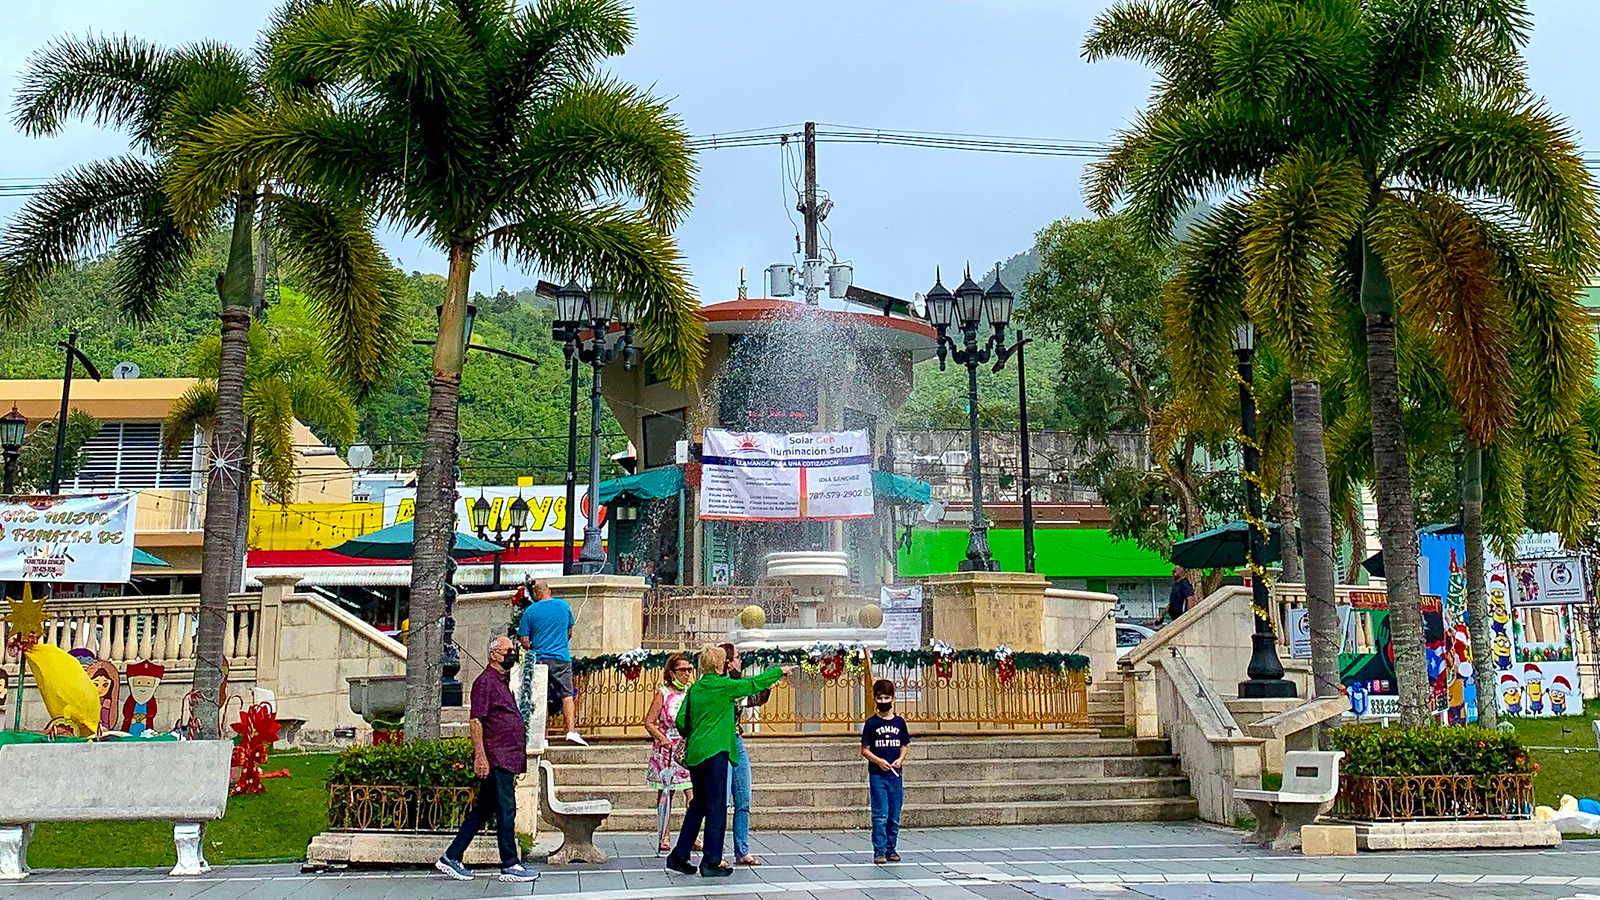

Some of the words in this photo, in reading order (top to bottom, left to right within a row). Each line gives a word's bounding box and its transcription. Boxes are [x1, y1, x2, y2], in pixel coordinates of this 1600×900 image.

[789, 436, 813, 445] Solar
[770, 446, 827, 456] Iluminación
[829, 445, 853, 455] Solar
[808, 489, 862, 500] 787-579-2902
[44, 511, 111, 525] NUEVO
[11, 528, 93, 544] FAMILIA
[97, 530, 124, 545] DE
[875, 725, 900, 736] TOMMY
